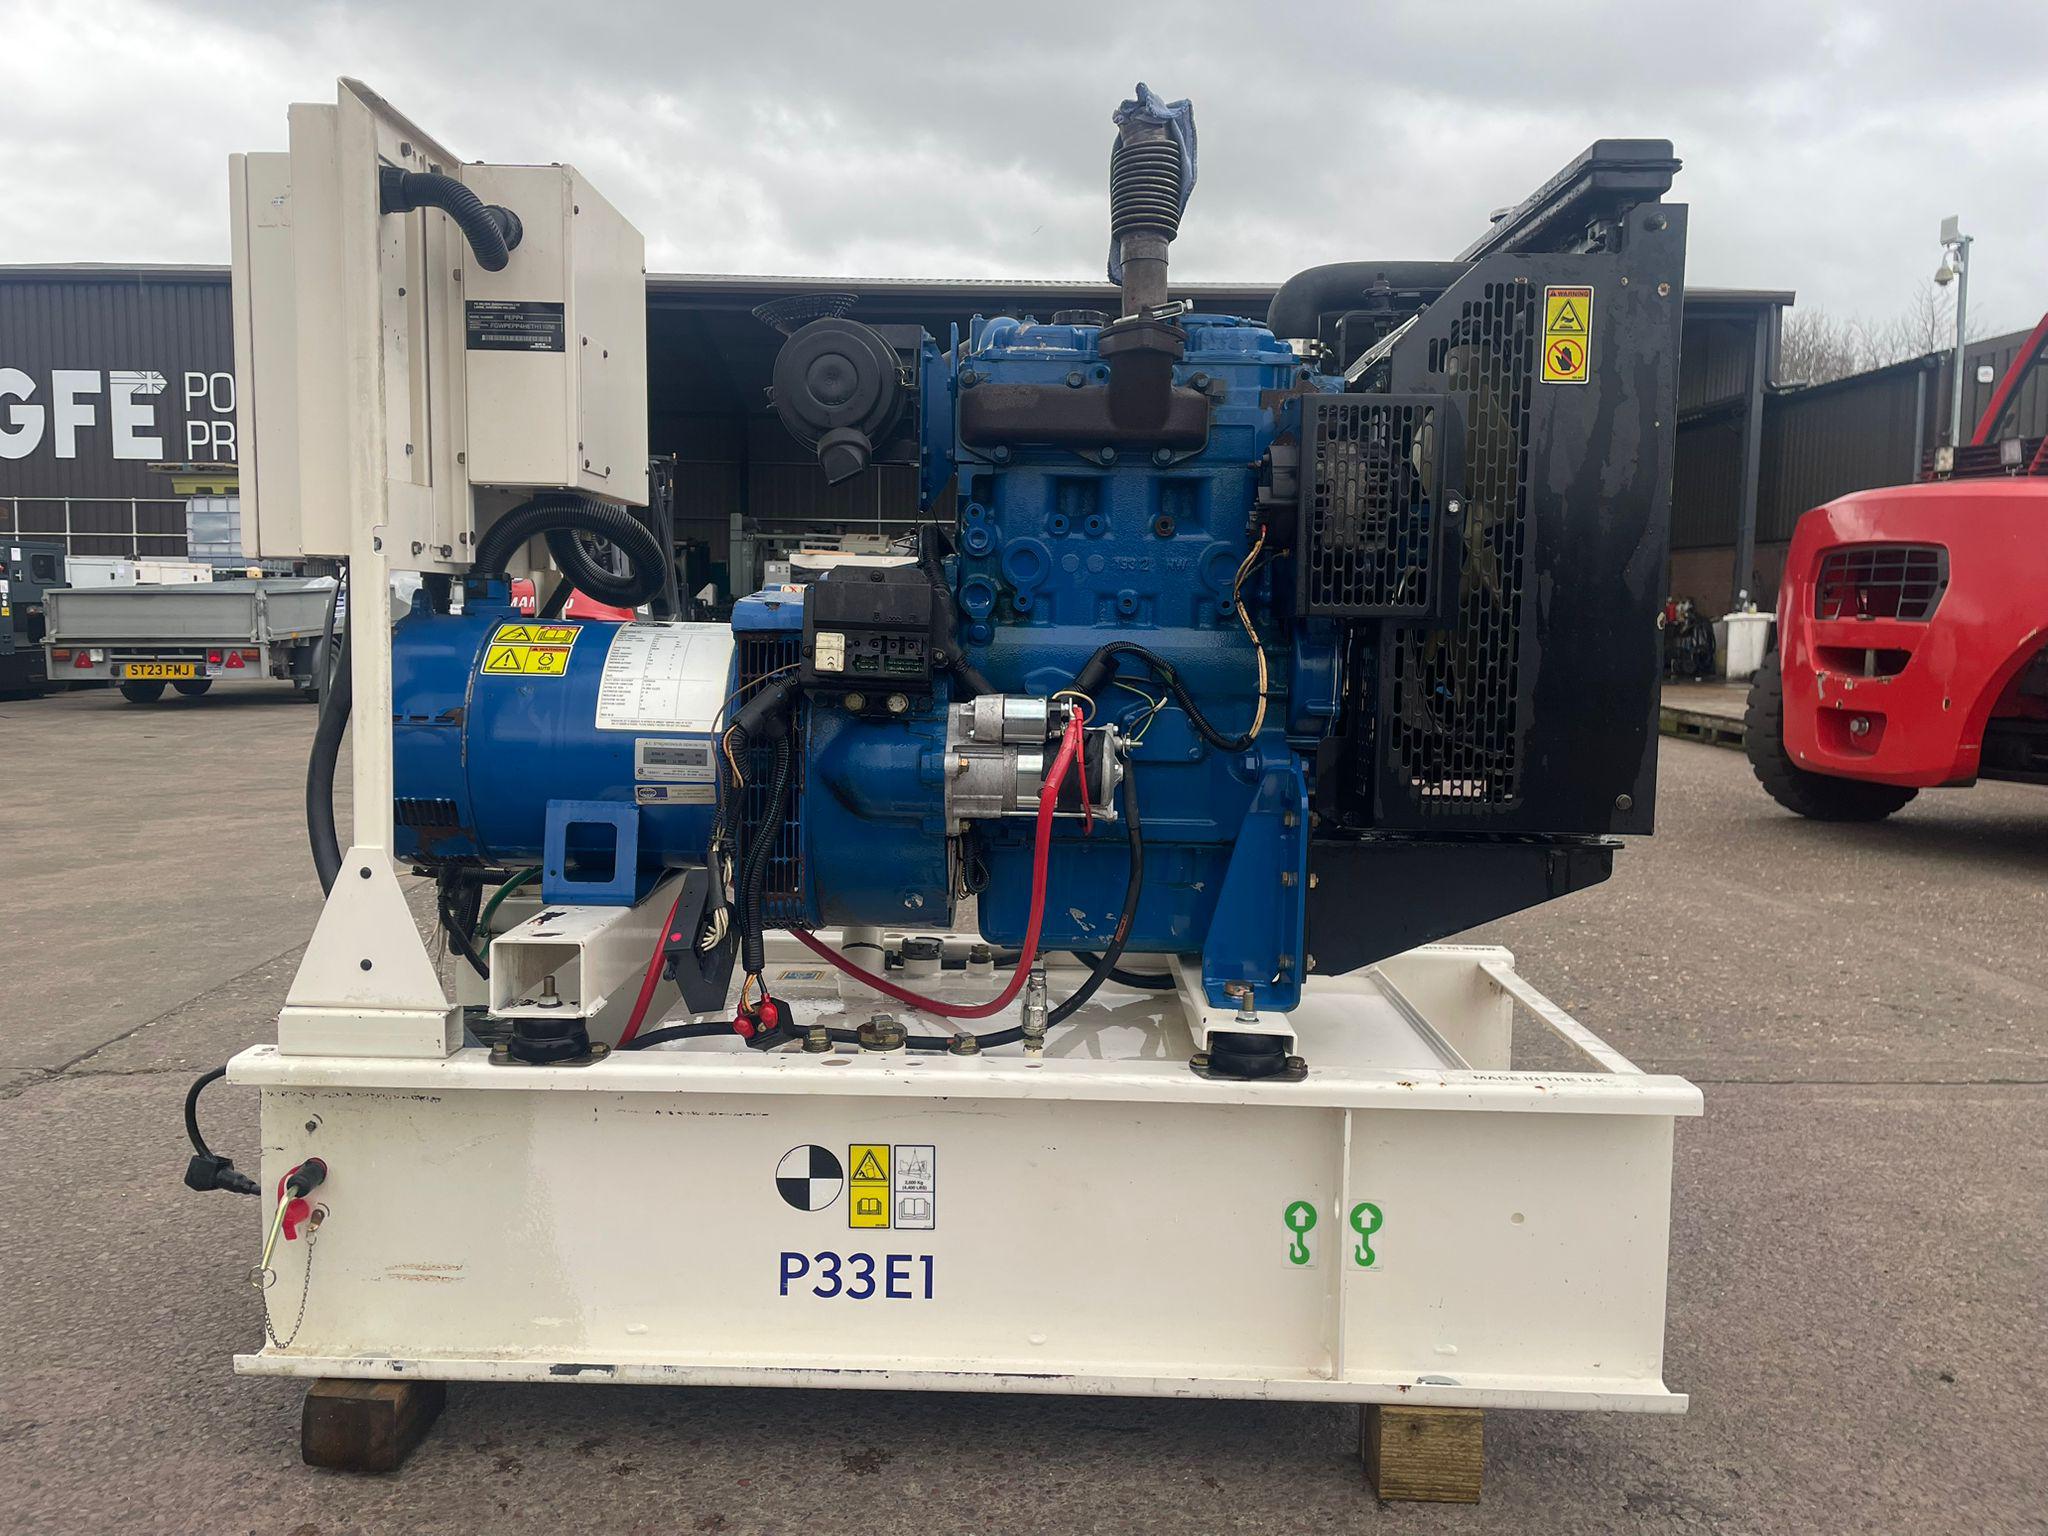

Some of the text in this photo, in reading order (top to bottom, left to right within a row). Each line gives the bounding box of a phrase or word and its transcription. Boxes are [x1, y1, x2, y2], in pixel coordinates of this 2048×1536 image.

[0, 368, 168, 459] GFE
[131, 665, 190, 676] ST23 FMJ
[779, 1251, 934, 1300] P33E1
